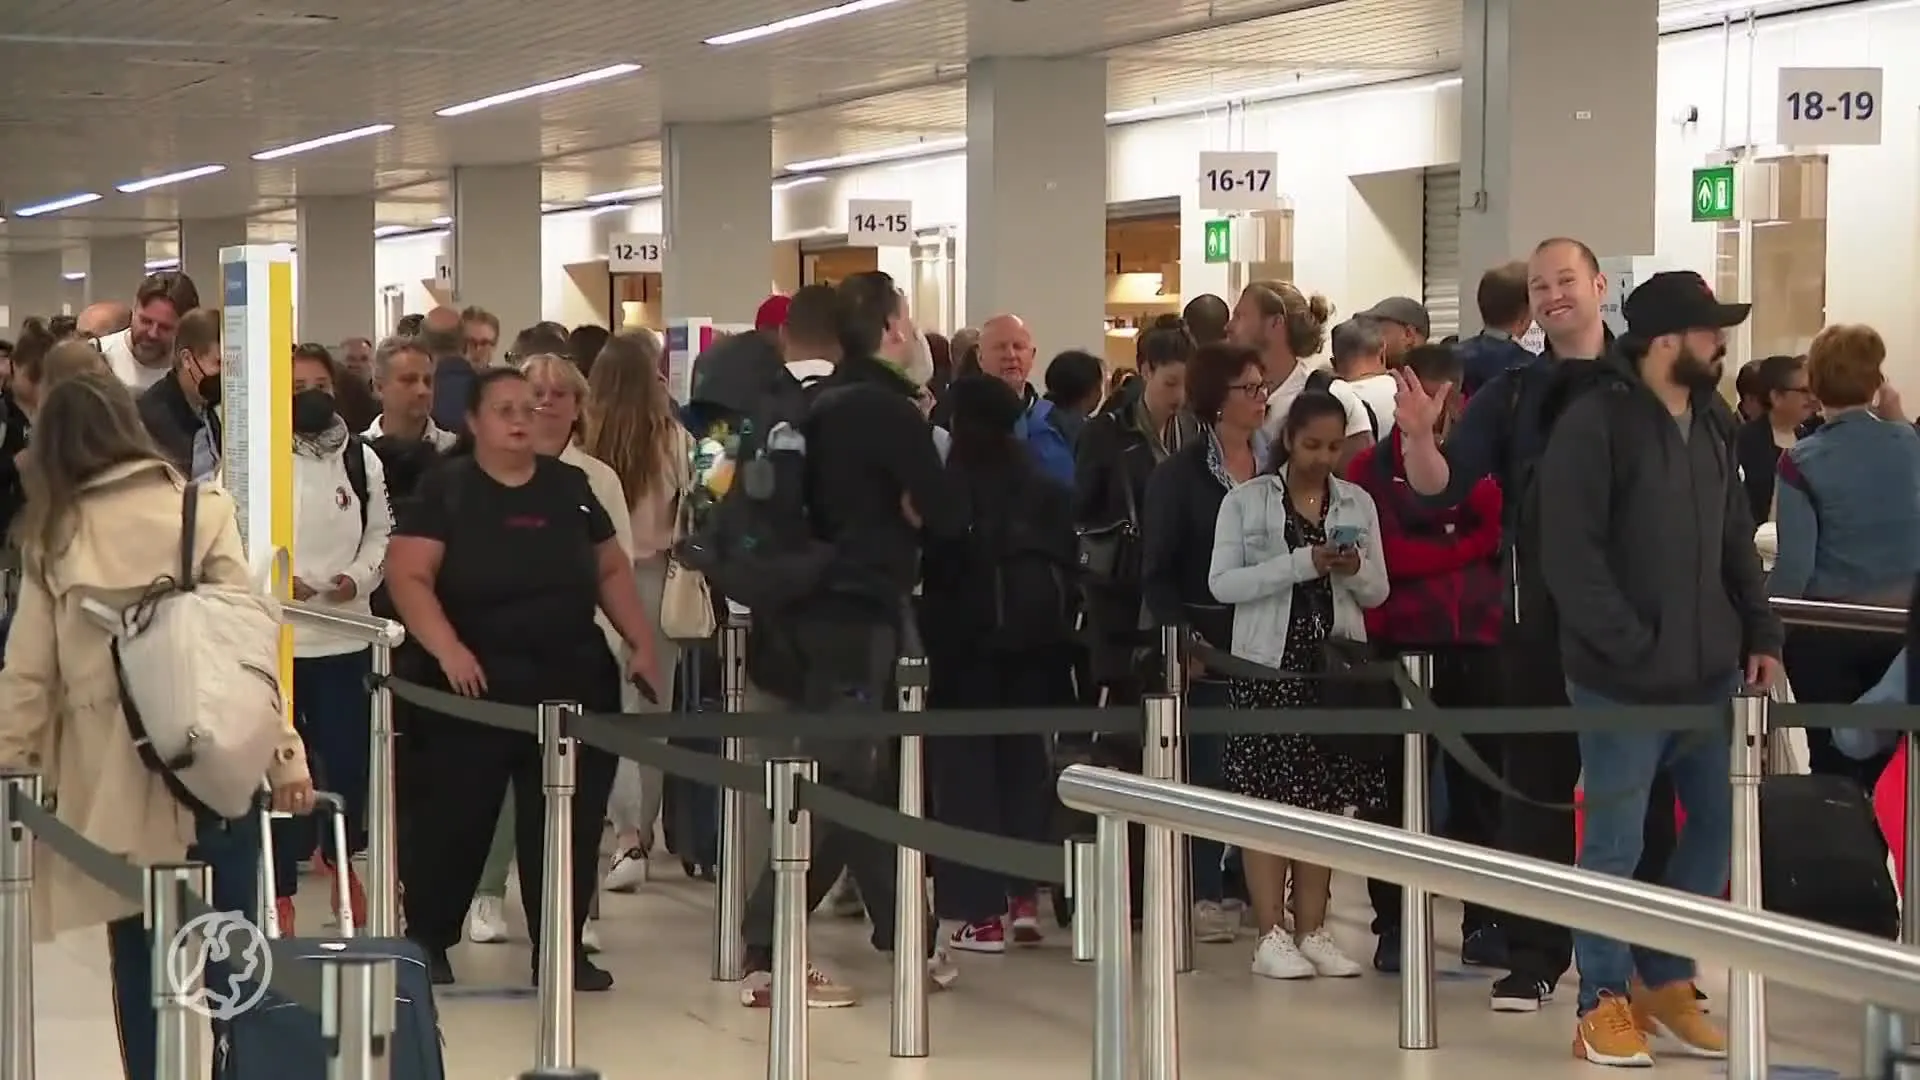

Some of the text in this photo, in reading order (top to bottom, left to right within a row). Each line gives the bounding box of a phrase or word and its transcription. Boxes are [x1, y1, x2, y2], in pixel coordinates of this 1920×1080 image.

[1787, 91, 1874, 120] 18-19
[1206, 169, 1271, 192] 16-17
[855, 213, 907, 232] 14-15
[615, 244, 658, 260] 12-13
